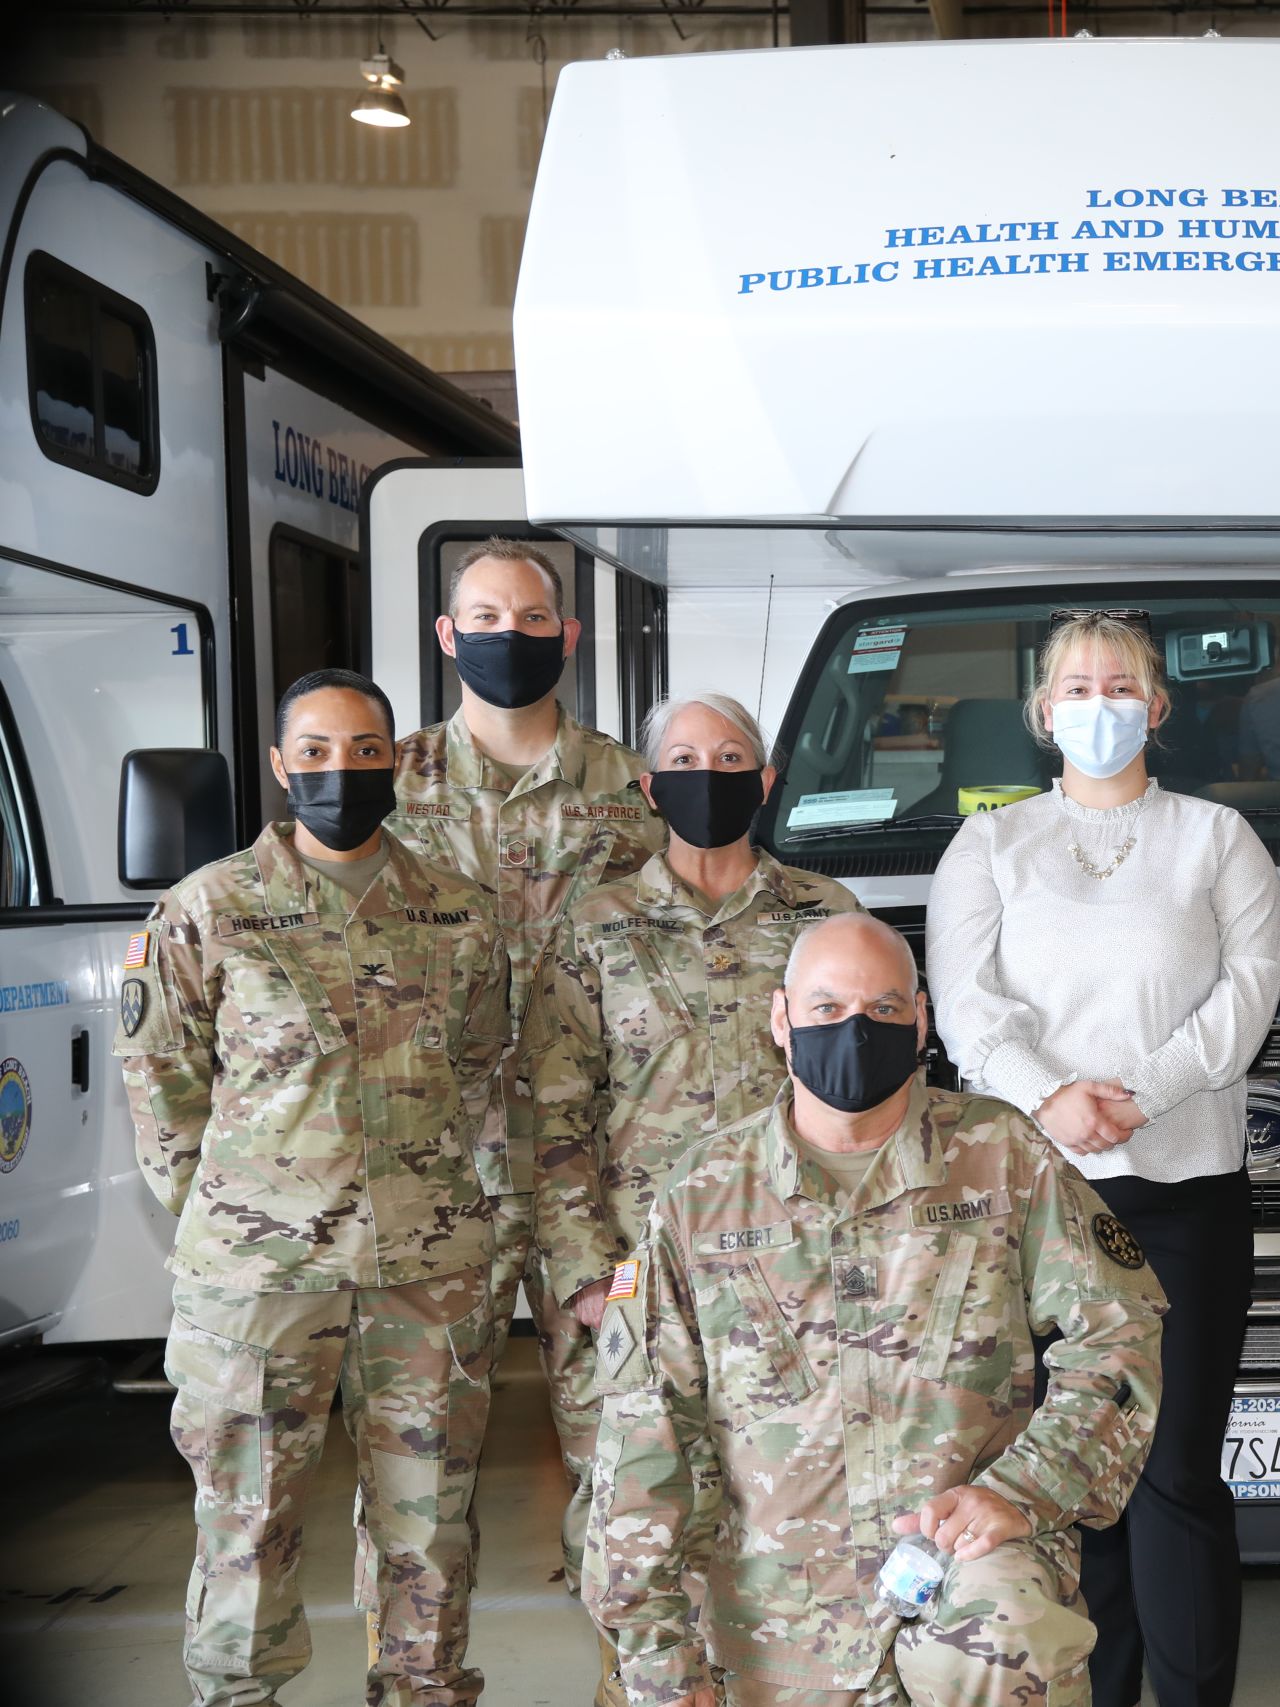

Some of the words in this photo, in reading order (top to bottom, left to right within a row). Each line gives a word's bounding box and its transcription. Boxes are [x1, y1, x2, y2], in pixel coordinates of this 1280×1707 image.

[1088, 189, 1208, 208] LONG
[886, 221, 1058, 249] HEALTH
[1073, 219, 1164, 239] AND
[739, 262, 899, 295] PUBLIC
[914, 252, 1088, 279] HEALTH
[272, 419, 324, 499] LONG
[170, 623, 194, 655] 1
[407, 802, 450, 817] WESTAD
[565, 805, 583, 817] U.S.
[588, 806, 604, 818] AIR
[608, 806, 640, 819] FORCE
[232, 914, 304, 931] HOEFLEIN
[0, 1219, 20, 1242] 060
[719, 1227, 772, 1250] ECKERT
